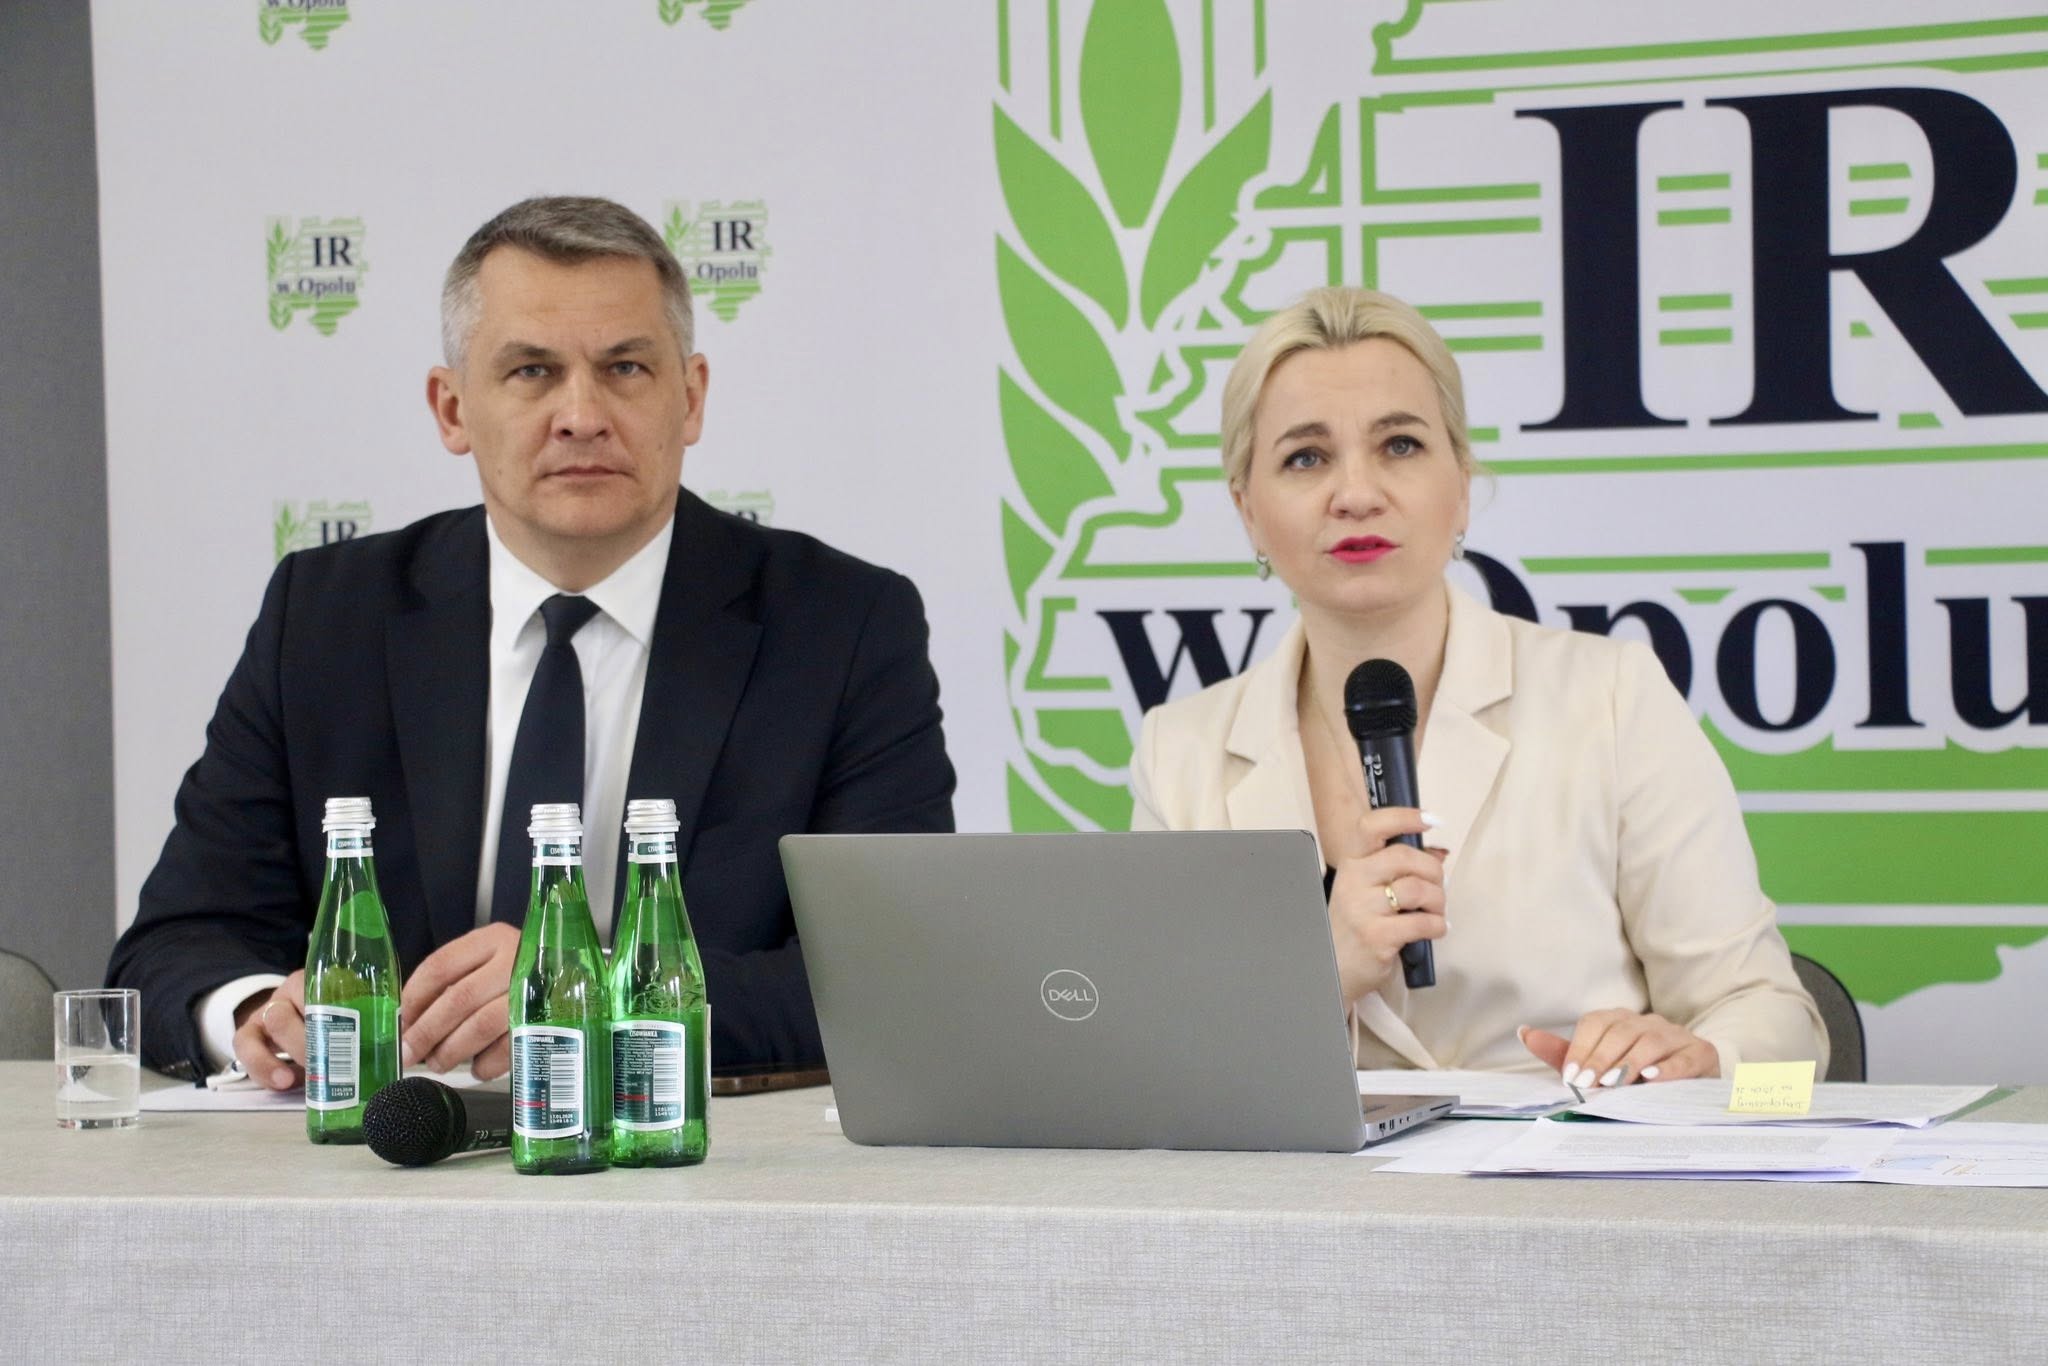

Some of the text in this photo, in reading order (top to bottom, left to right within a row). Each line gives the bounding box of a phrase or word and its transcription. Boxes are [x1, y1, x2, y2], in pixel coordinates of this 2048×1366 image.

[713, 220, 755, 251] IR
[313, 237, 353, 267] IR
[1514, 86, 2048, 432] IR
[697, 261, 757, 284] Opolu
[298, 277, 356, 299] Opolu
[1095, 608, 1275, 717] w
[1048, 989, 1093, 1001] DELL
